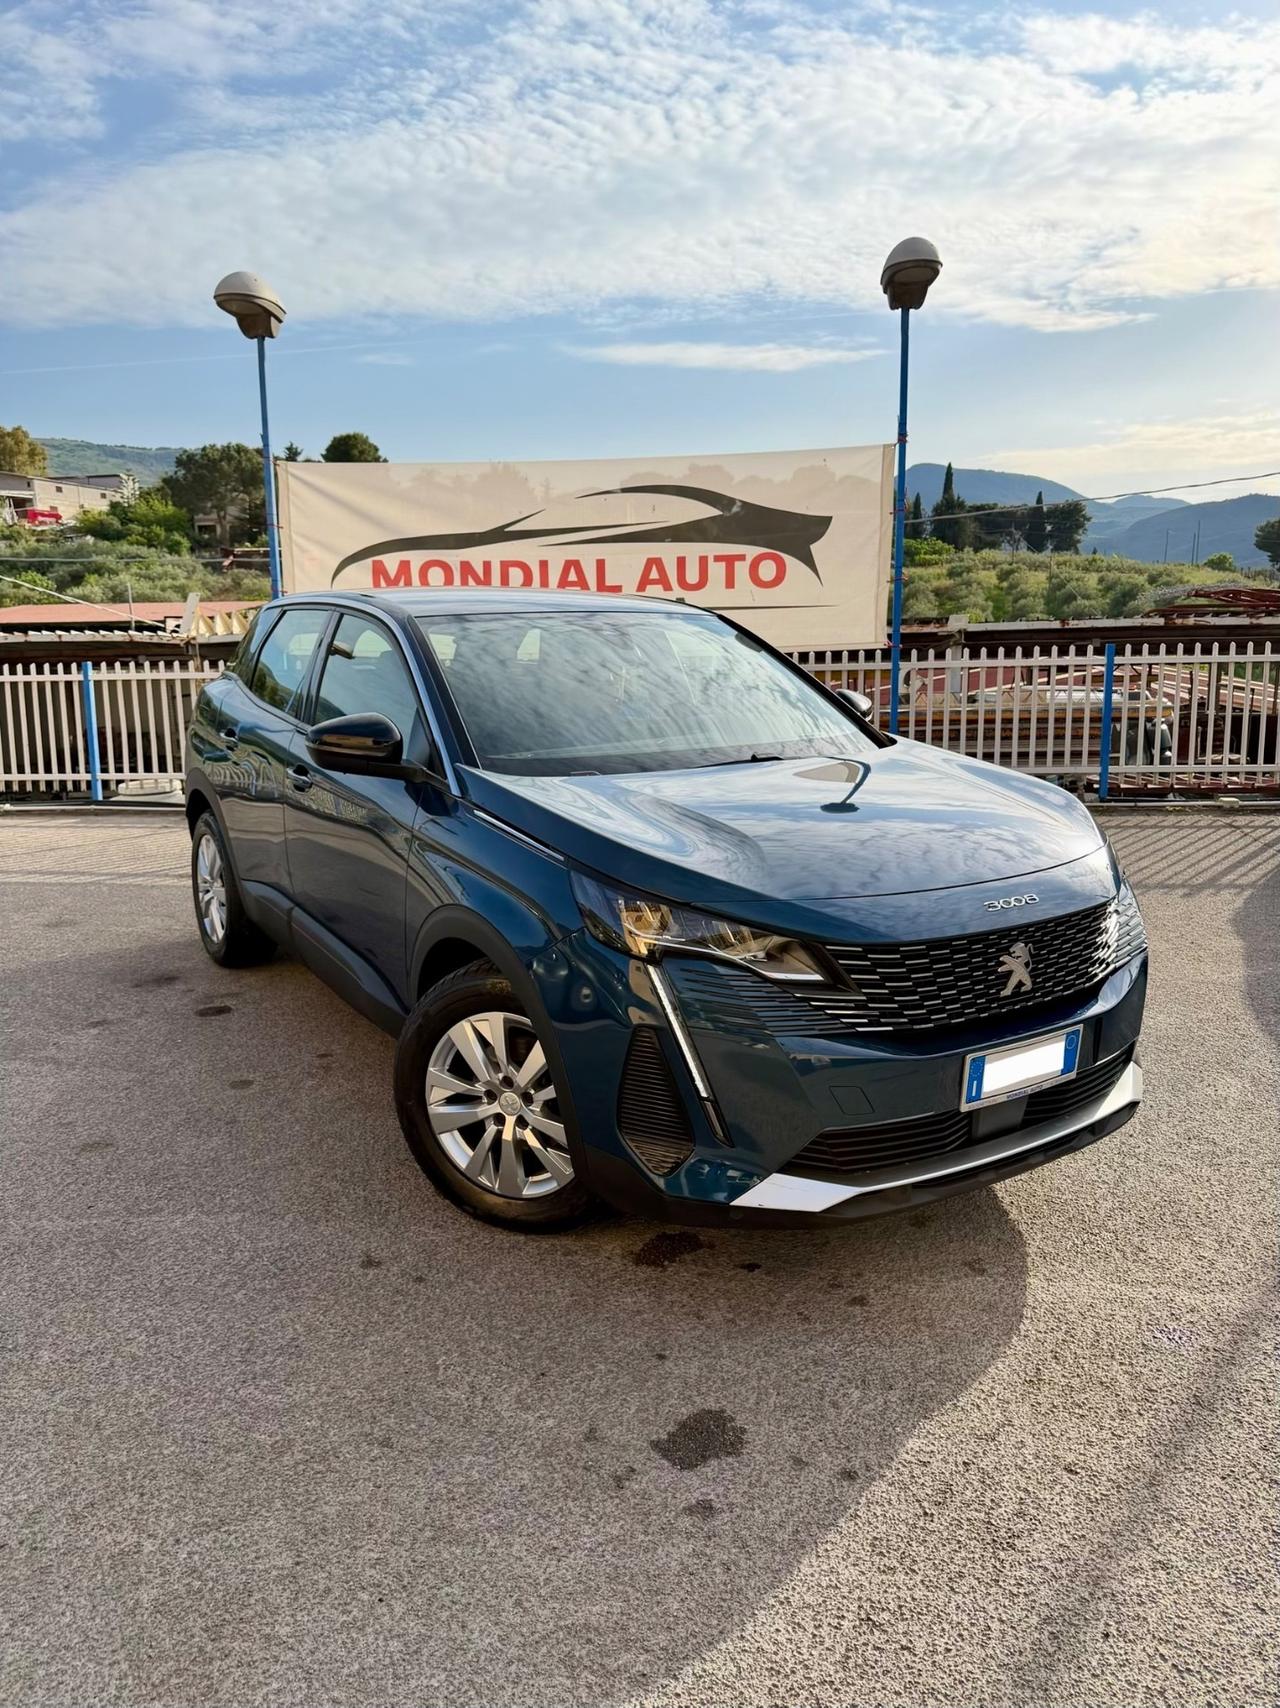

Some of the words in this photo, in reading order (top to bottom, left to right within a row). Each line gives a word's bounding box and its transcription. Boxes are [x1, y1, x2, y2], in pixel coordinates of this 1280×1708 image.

[371, 558, 623, 593] MONDIAL
[635, 551, 787, 592] AUTO
[983, 893, 1040, 912] 3008
[1006, 1089, 1029, 1100] MONDIAL
[1029, 1084, 1043, 1094] AUTO
